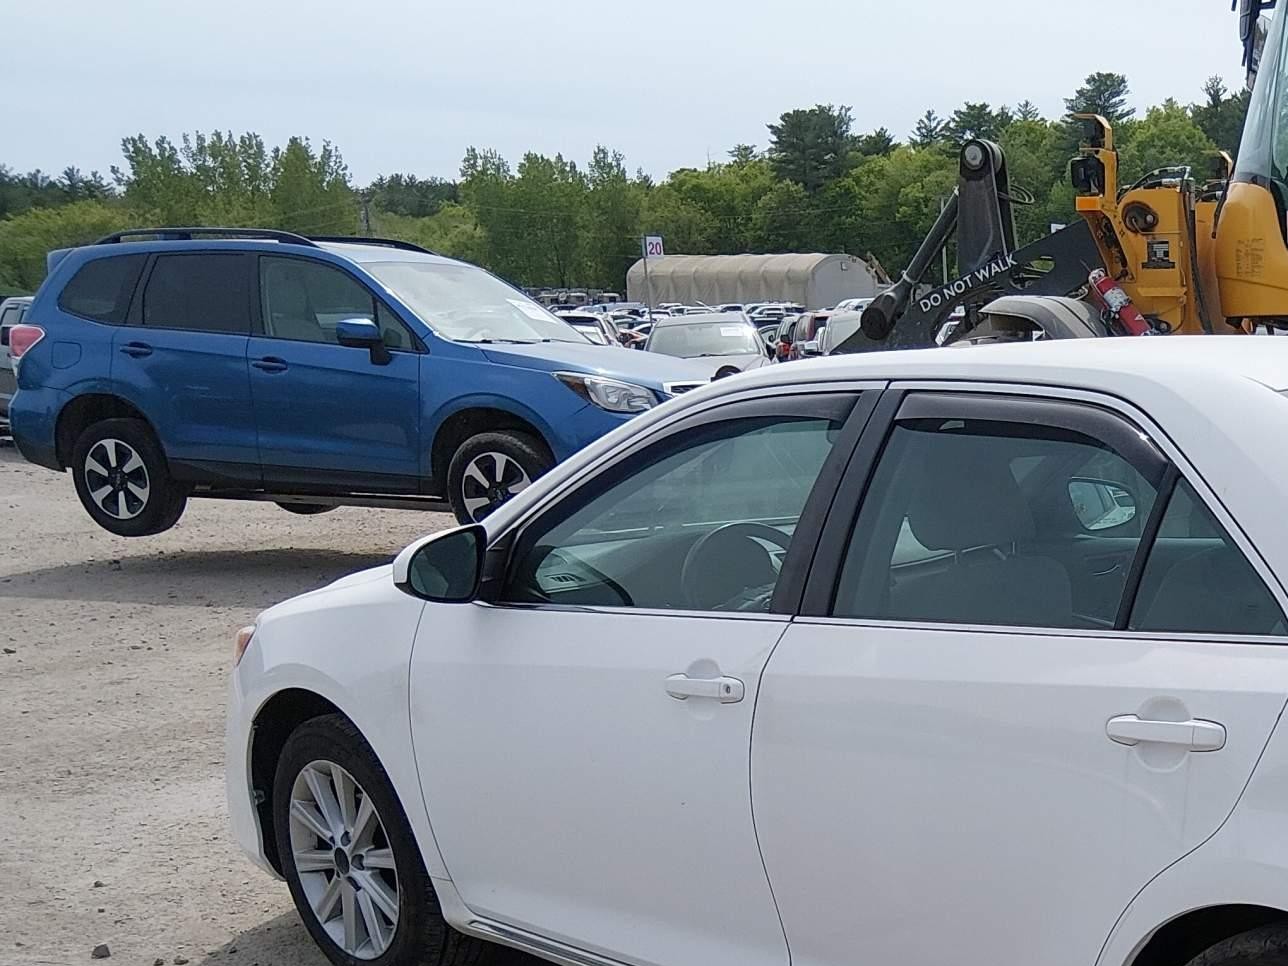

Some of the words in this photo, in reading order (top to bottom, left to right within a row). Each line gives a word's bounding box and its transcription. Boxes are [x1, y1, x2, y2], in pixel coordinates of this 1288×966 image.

[648, 241, 662, 255] 20
[920, 293, 941, 312] DO
[943, 274, 973, 300] NOT
[975, 253, 1018, 282] WALK
